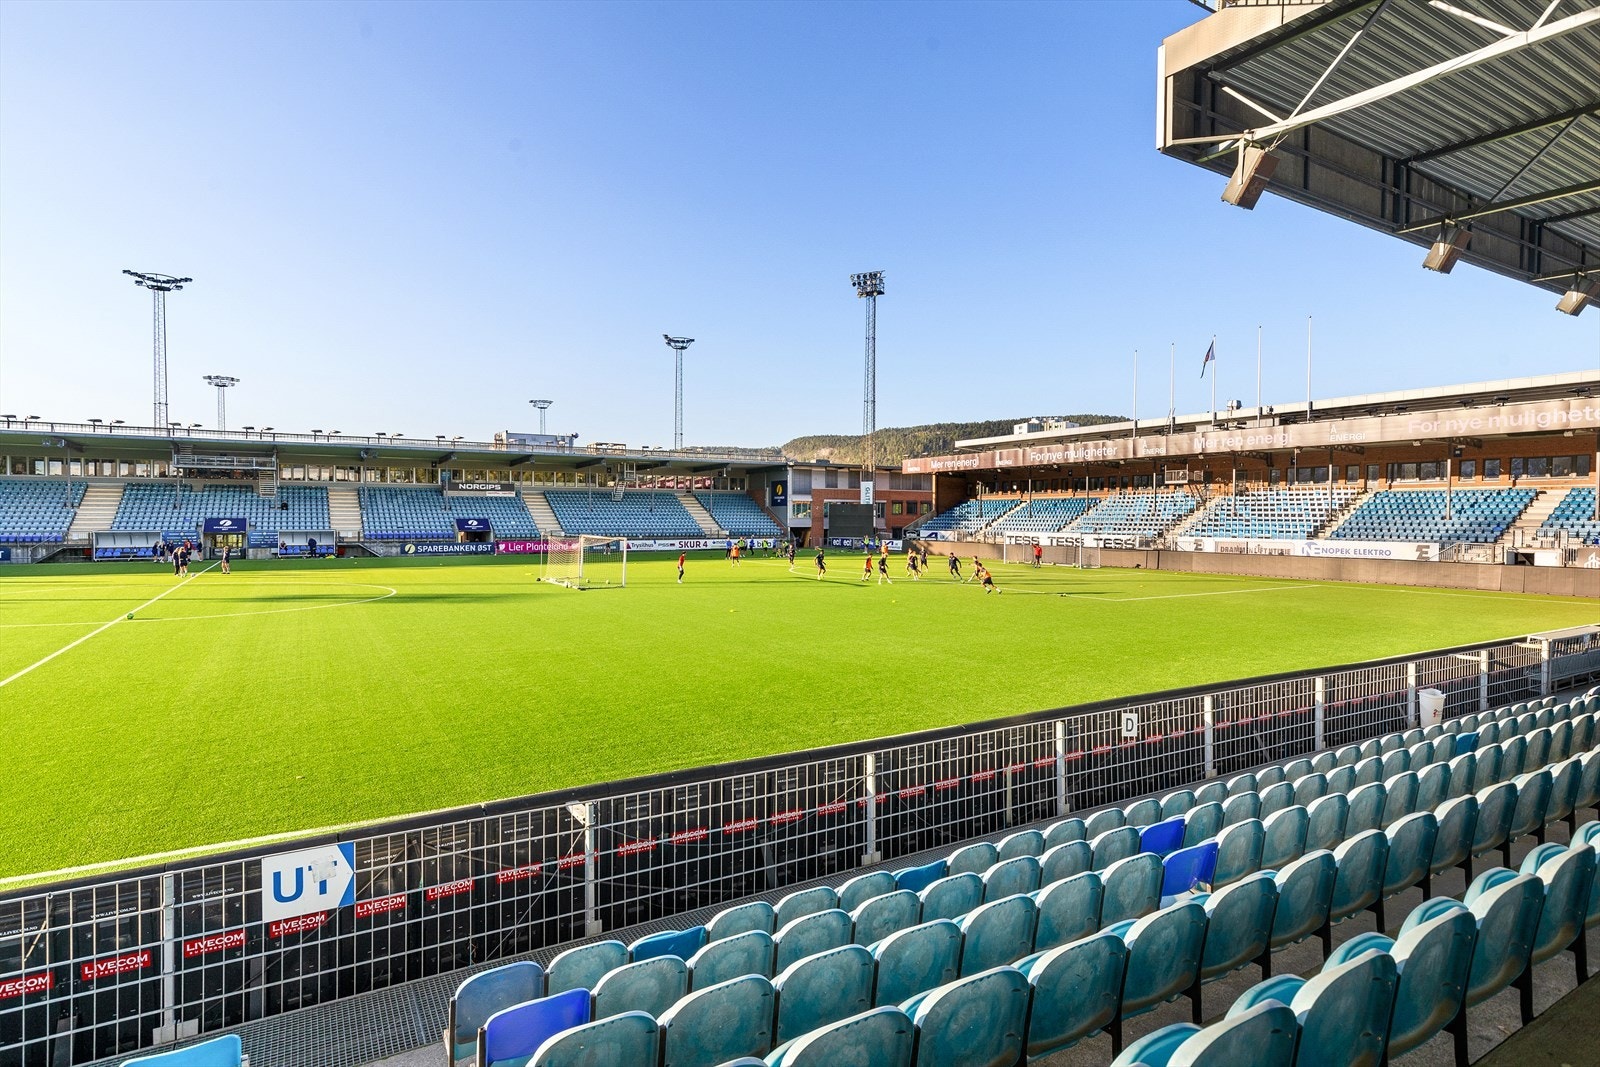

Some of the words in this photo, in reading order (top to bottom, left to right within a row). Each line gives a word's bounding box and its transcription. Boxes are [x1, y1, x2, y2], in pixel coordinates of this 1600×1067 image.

[1408, 419, 1440, 434] For
[1446, 417, 1482, 434] nye
[1193, 437, 1218, 449] Mer
[1247, 432, 1293, 446] energi
[1330, 433, 1366, 442] ENERGI
[1030, 451, 1044, 461] For
[1047, 451, 1062, 462] nye
[1064, 446, 1118, 460] muligheter
[931, 460, 944, 469] Mer
[508, 542, 525, 551] Lier
[526, 542, 569, 551] Planteland
[678, 541, 701, 549] SKUR
[1007, 535, 1040, 545] TESS
[1047, 536, 1085, 547] TESS
[1093, 538, 1135, 549] TESS
[417, 544, 476, 553] SPAREBANKEN
[477, 544, 492, 552] ØST
[1321, 547, 1351, 555] NOPEK
[1353, 548, 1392, 556] ELEKTRO
[1125, 717, 1134, 732] D
[428, 880, 473, 896] LIVECOM
[357, 895, 405, 913] LIVECOM
[272, 913, 326, 932] LIVECOM
[186, 932, 244, 952] LIVECOM
[84, 953, 149, 975] LIVECOM
